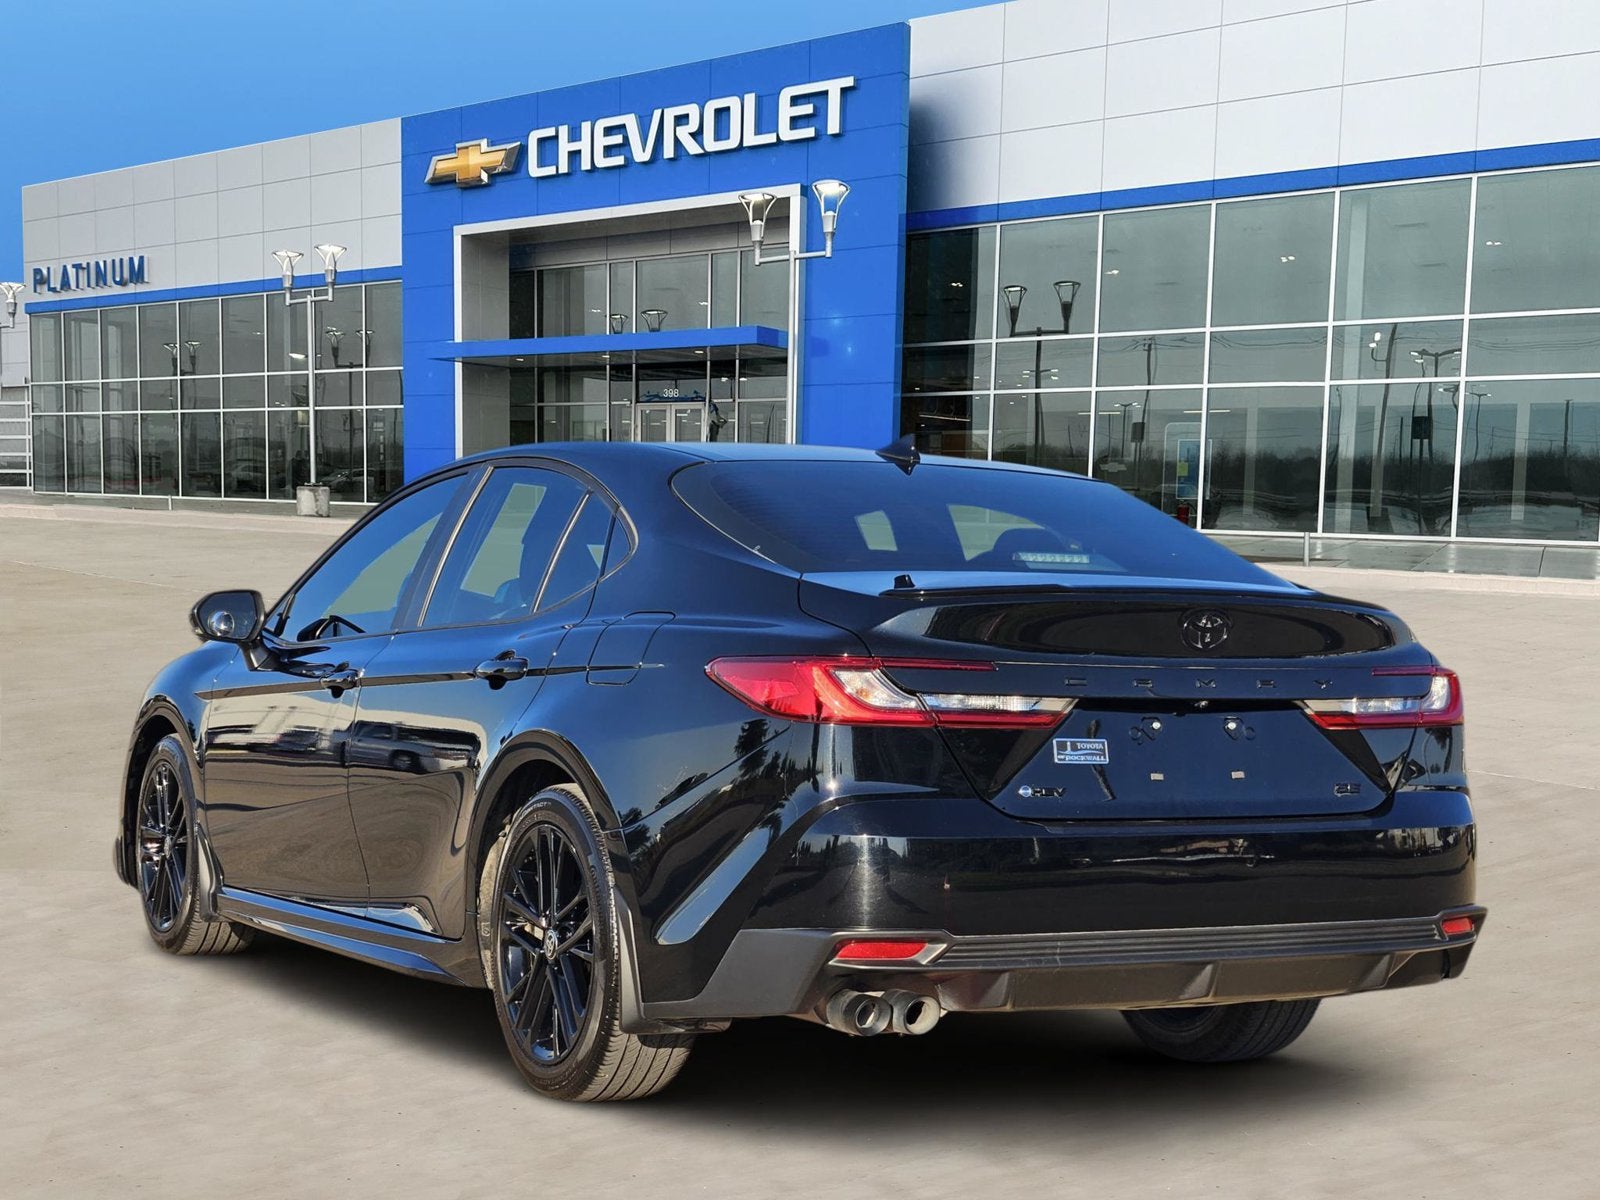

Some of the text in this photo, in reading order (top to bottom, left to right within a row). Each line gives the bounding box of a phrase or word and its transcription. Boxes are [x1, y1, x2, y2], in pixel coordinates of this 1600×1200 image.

[527, 76, 855, 178] CHEVROLET
[33, 255, 146, 293] PLATINUM
[663, 388, 679, 398] 398
[1076, 742, 1104, 750] TOYOTA
